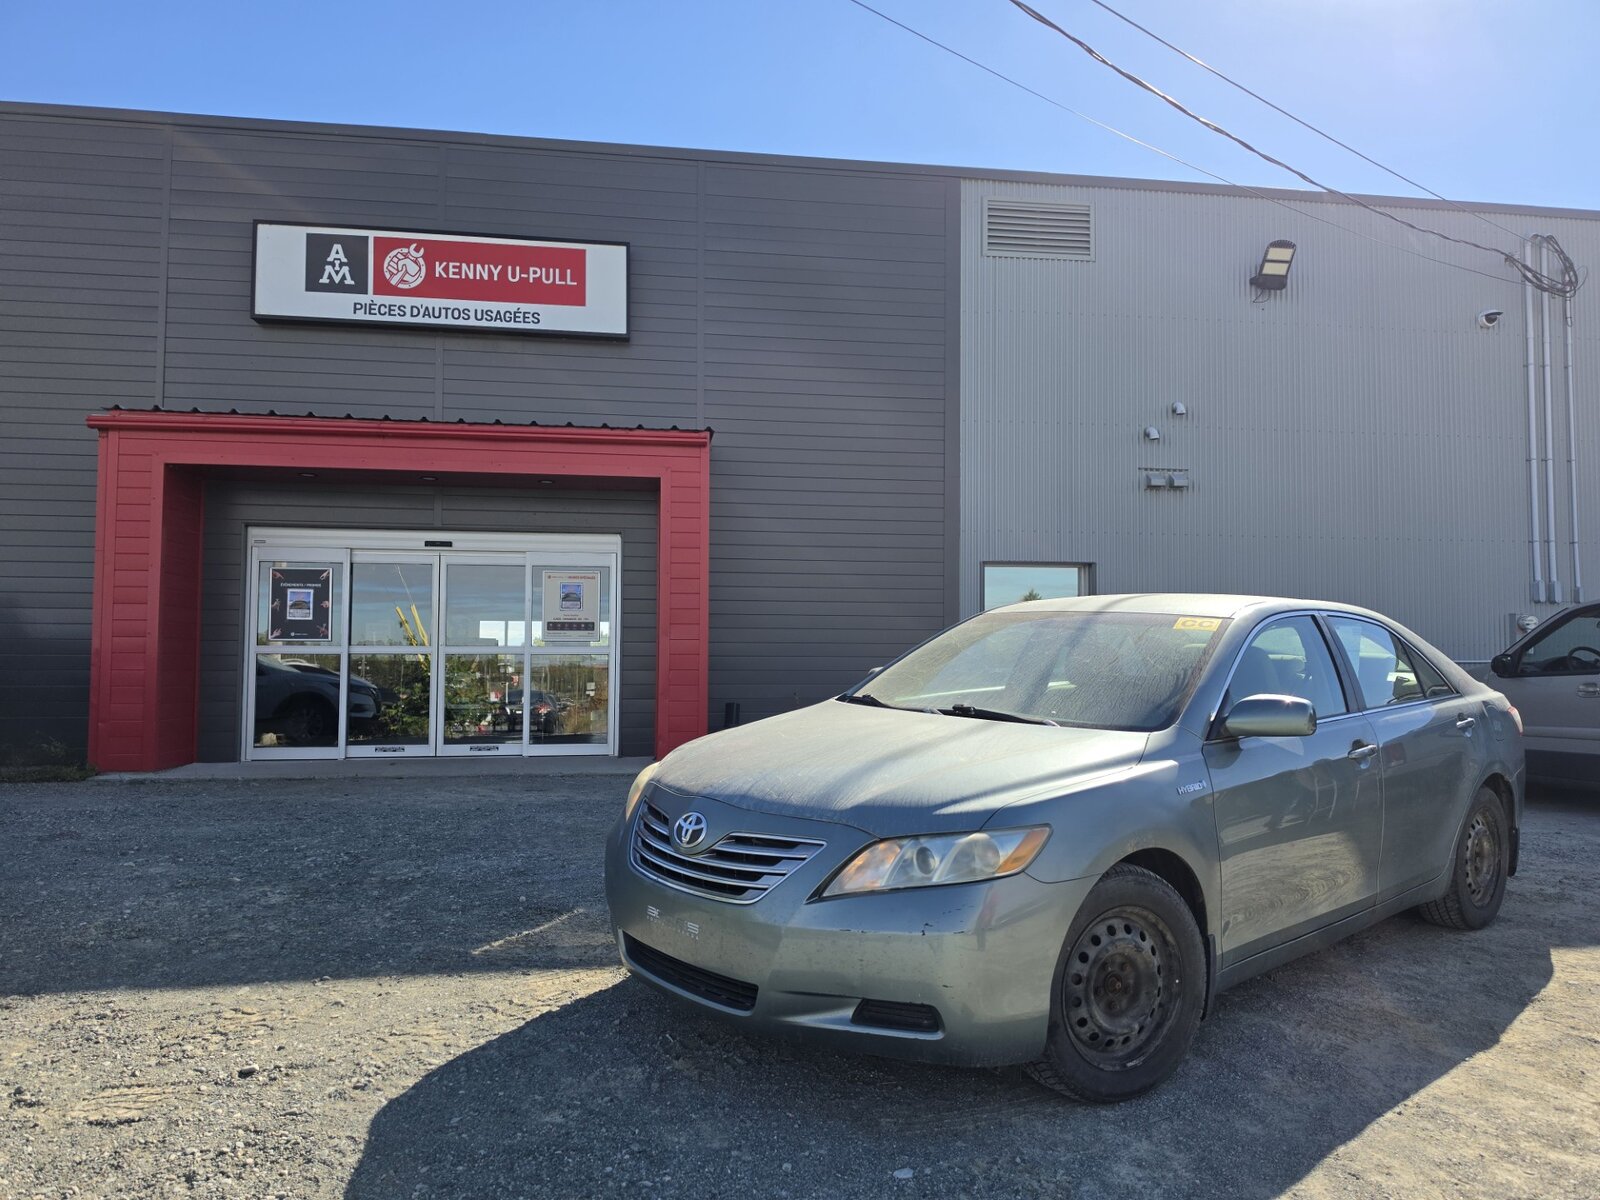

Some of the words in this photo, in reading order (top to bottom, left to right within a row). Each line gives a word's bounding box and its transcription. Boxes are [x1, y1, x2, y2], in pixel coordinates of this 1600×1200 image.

[434, 261, 503, 282] KENNY
[507, 265, 578, 286] U-PULL
[352, 299, 407, 317] PIÈCES
[410, 304, 471, 321] D'AUTOS
[474, 307, 541, 325] USAGÉES
[1177, 780, 1207, 795] HYBRID
